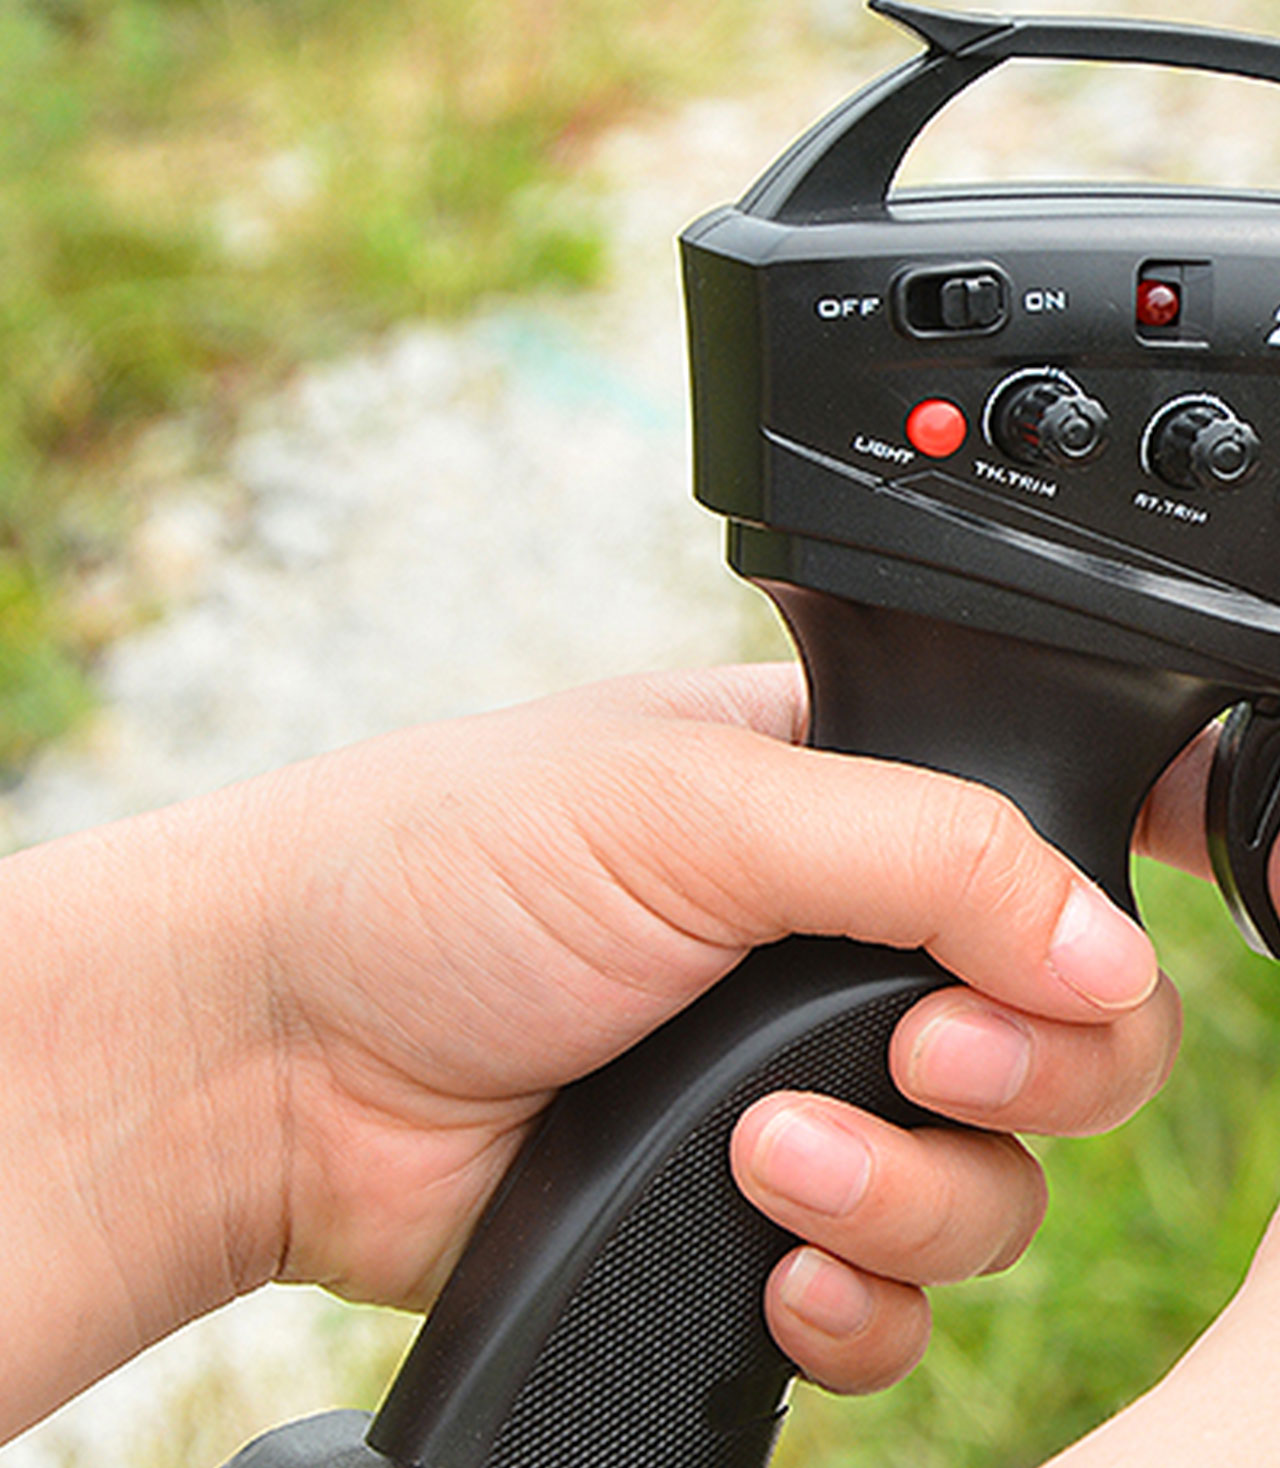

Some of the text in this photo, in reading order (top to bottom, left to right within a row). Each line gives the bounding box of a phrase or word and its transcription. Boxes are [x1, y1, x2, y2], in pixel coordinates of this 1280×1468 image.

[818, 297, 880, 318] OFF
[1024, 288, 1066, 311] ON
[854, 436, 914, 464] LIGHT
